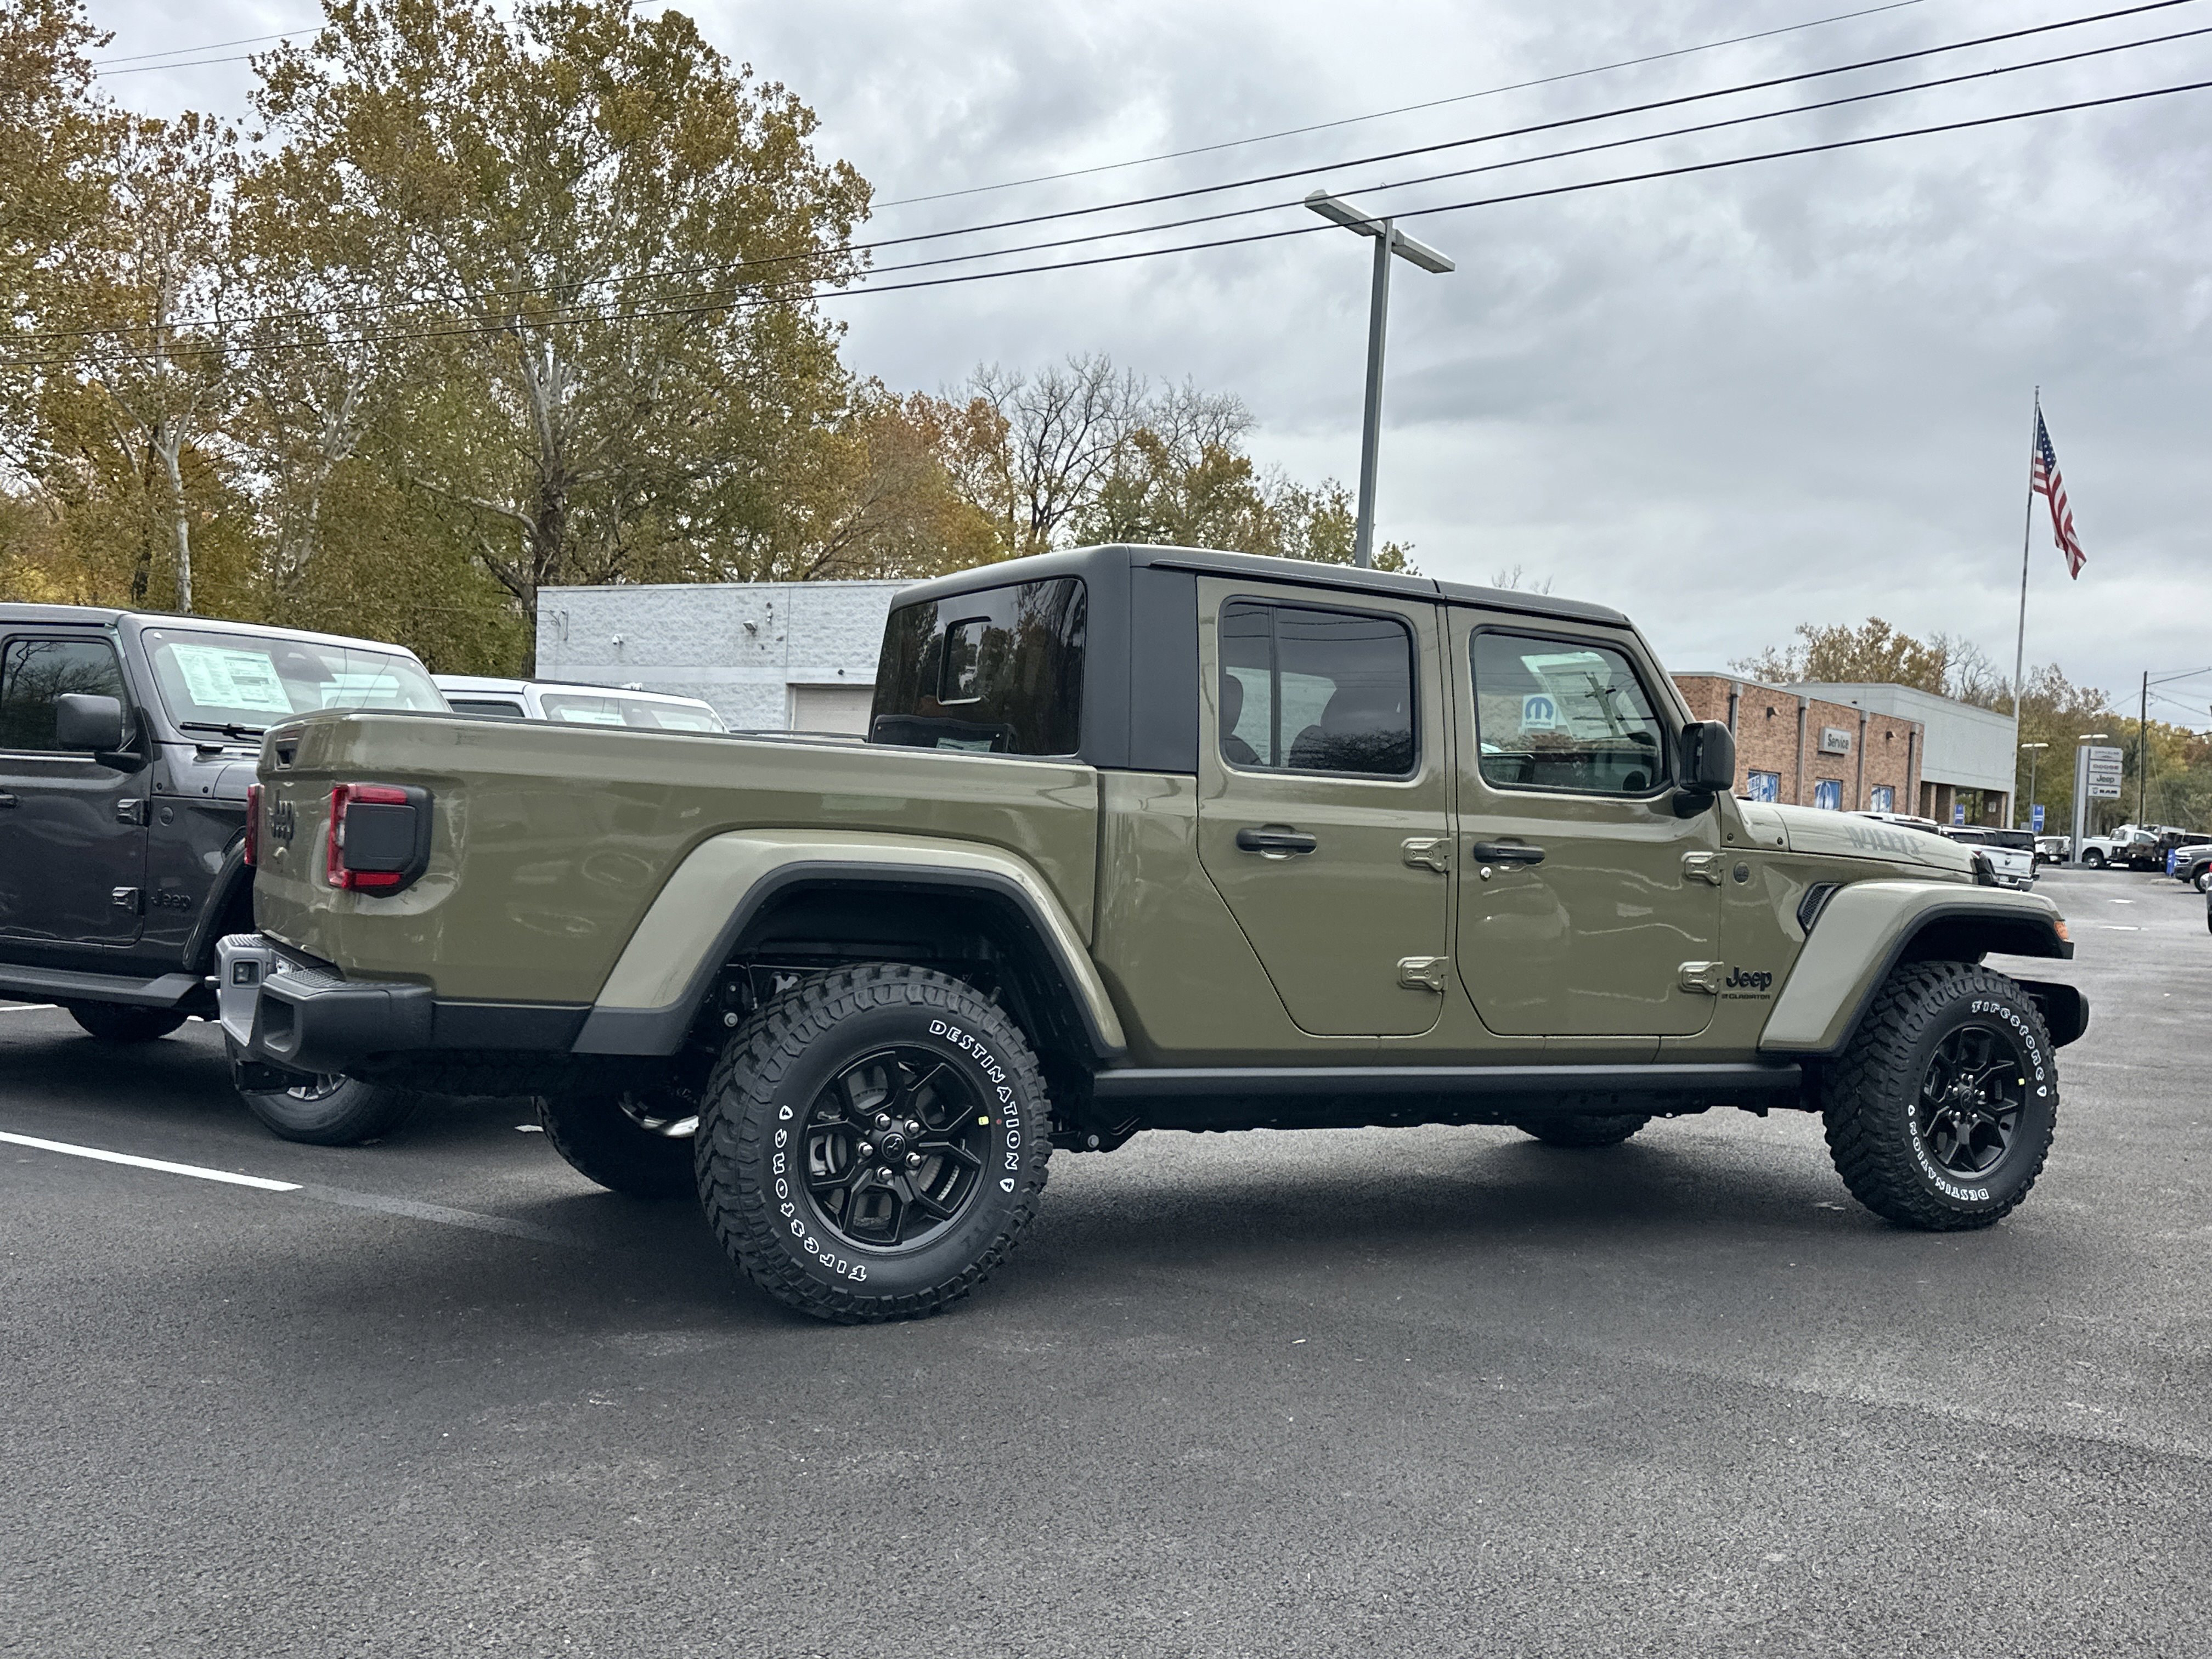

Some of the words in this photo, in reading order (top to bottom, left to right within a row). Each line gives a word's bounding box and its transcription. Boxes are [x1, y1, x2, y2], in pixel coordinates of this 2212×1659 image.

[1827, 733, 1849, 749] Service
[2096, 774, 2115, 783] Jeep
[151, 888, 191, 911] Jeep
[1726, 966, 1772, 991] Jeep
[929, 1019, 1021, 1170] DESTINATION
[1909, 1121, 1990, 1201] DESTINATION
